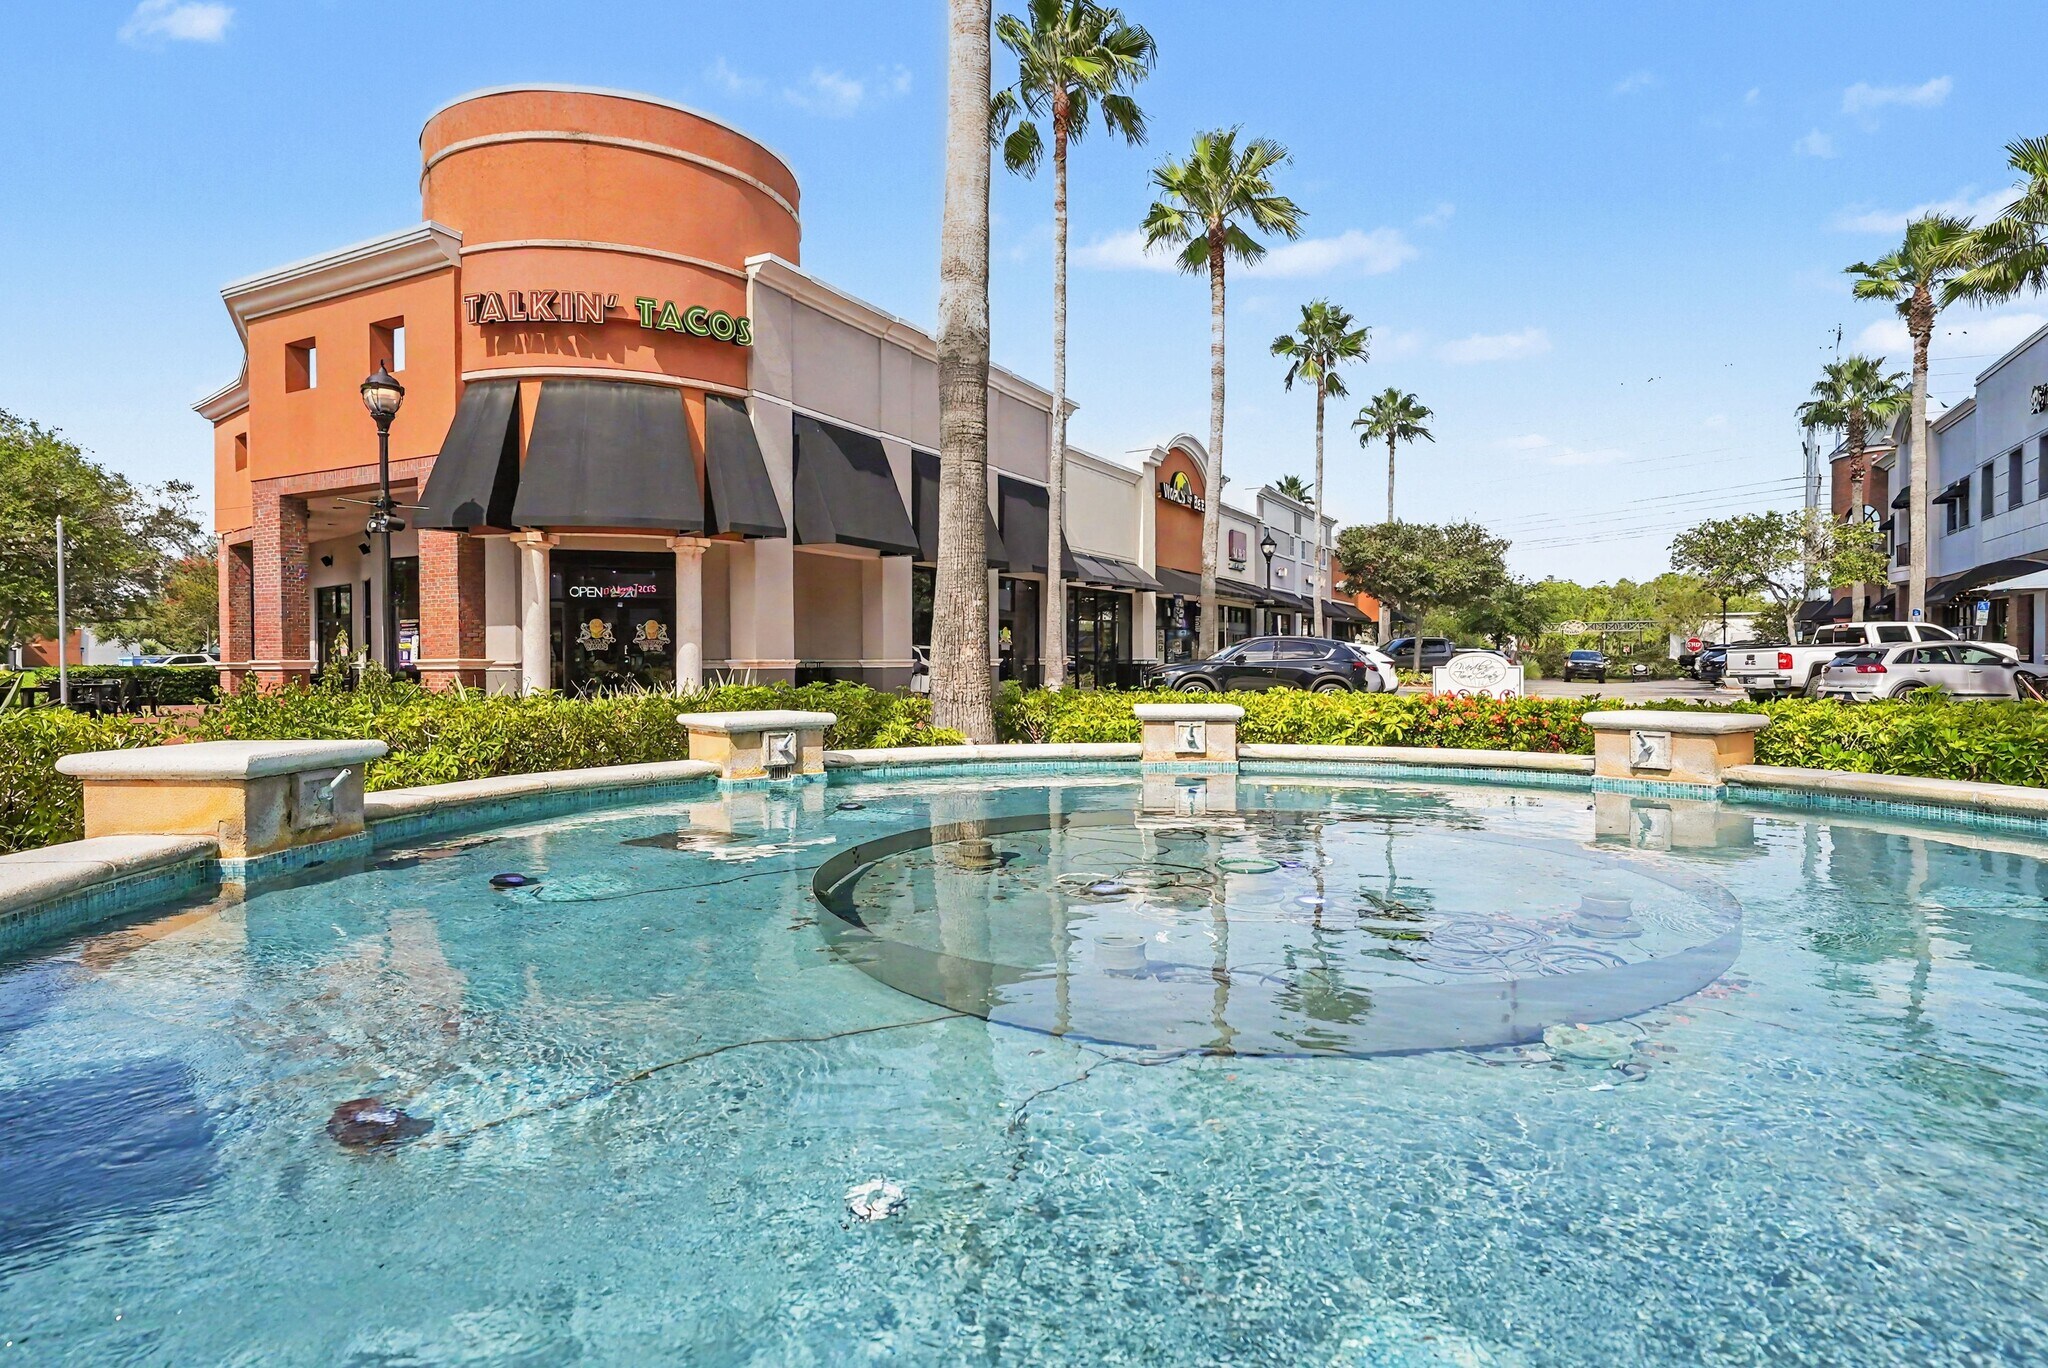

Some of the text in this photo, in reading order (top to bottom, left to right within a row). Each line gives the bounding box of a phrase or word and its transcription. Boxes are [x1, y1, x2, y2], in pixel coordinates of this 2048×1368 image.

[463, 289, 754, 347] TALKIN' TACOS
[569, 585, 603, 598] OPEN
